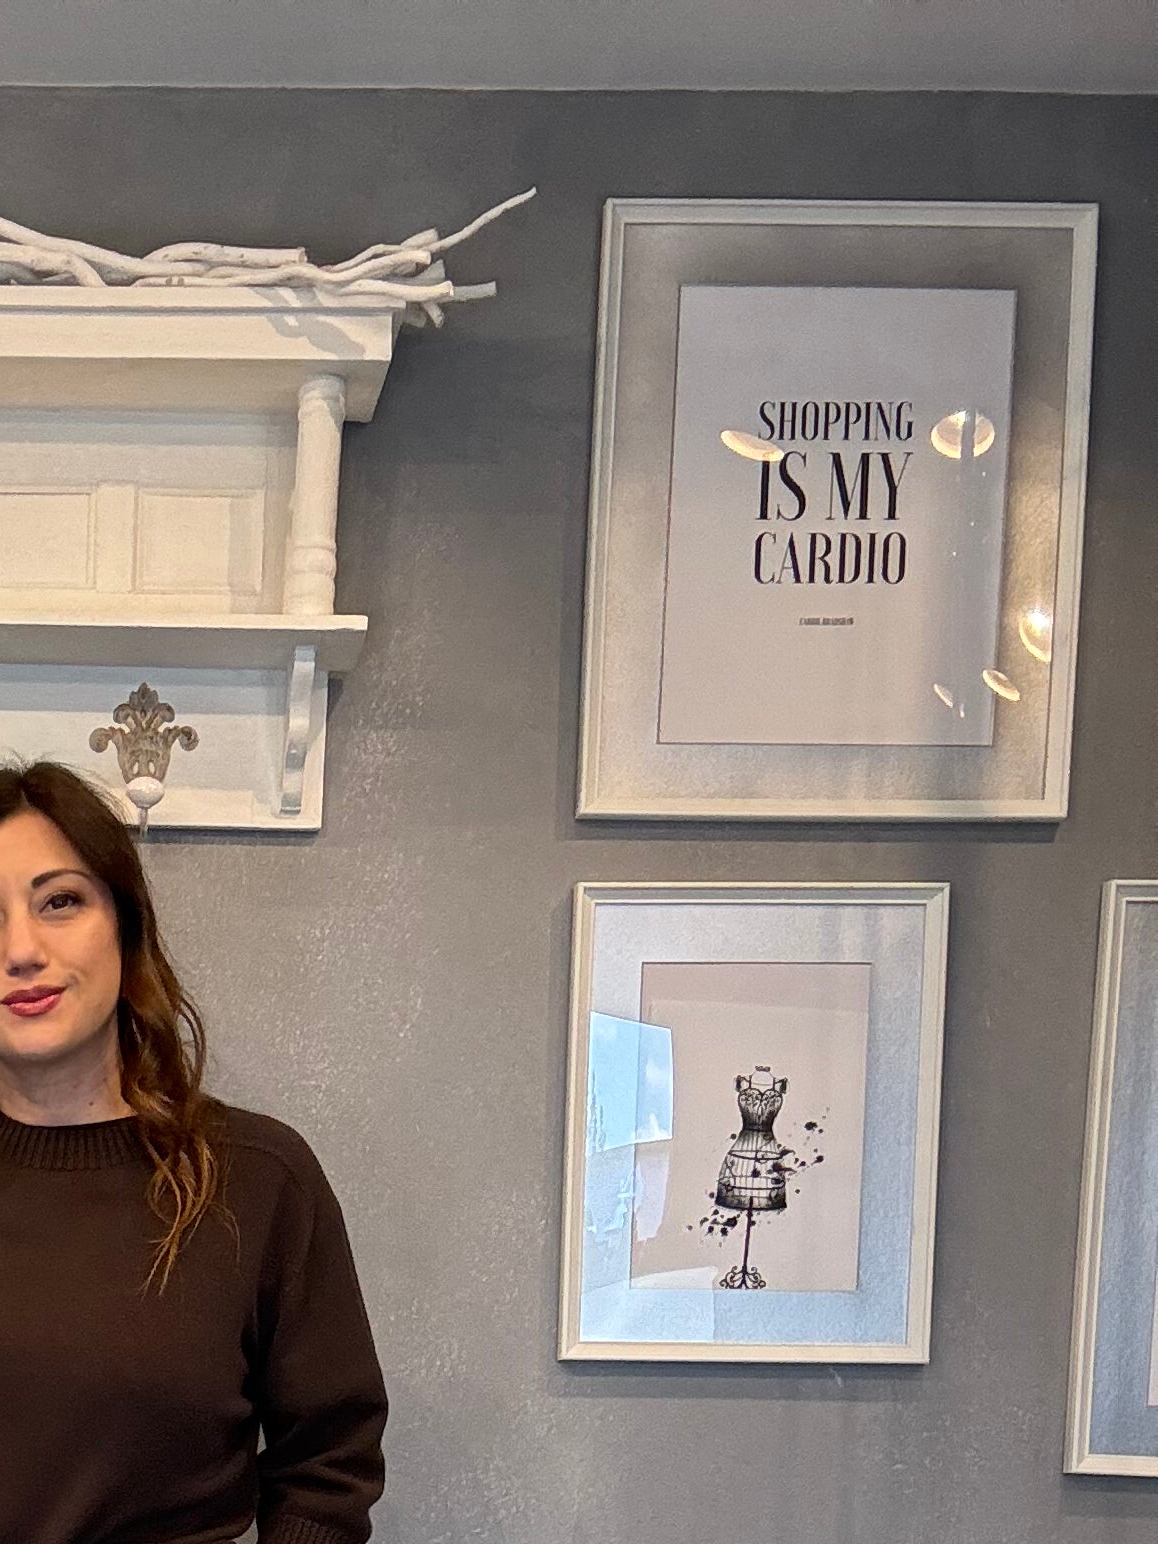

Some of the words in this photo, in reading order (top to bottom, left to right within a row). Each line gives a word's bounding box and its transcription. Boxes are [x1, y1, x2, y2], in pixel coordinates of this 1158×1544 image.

[758, 401, 914, 442] SHOPPING
[755, 451, 808, 522] IS
[825, 451, 915, 522] MY
[753, 531, 907, 585] CARDIO
